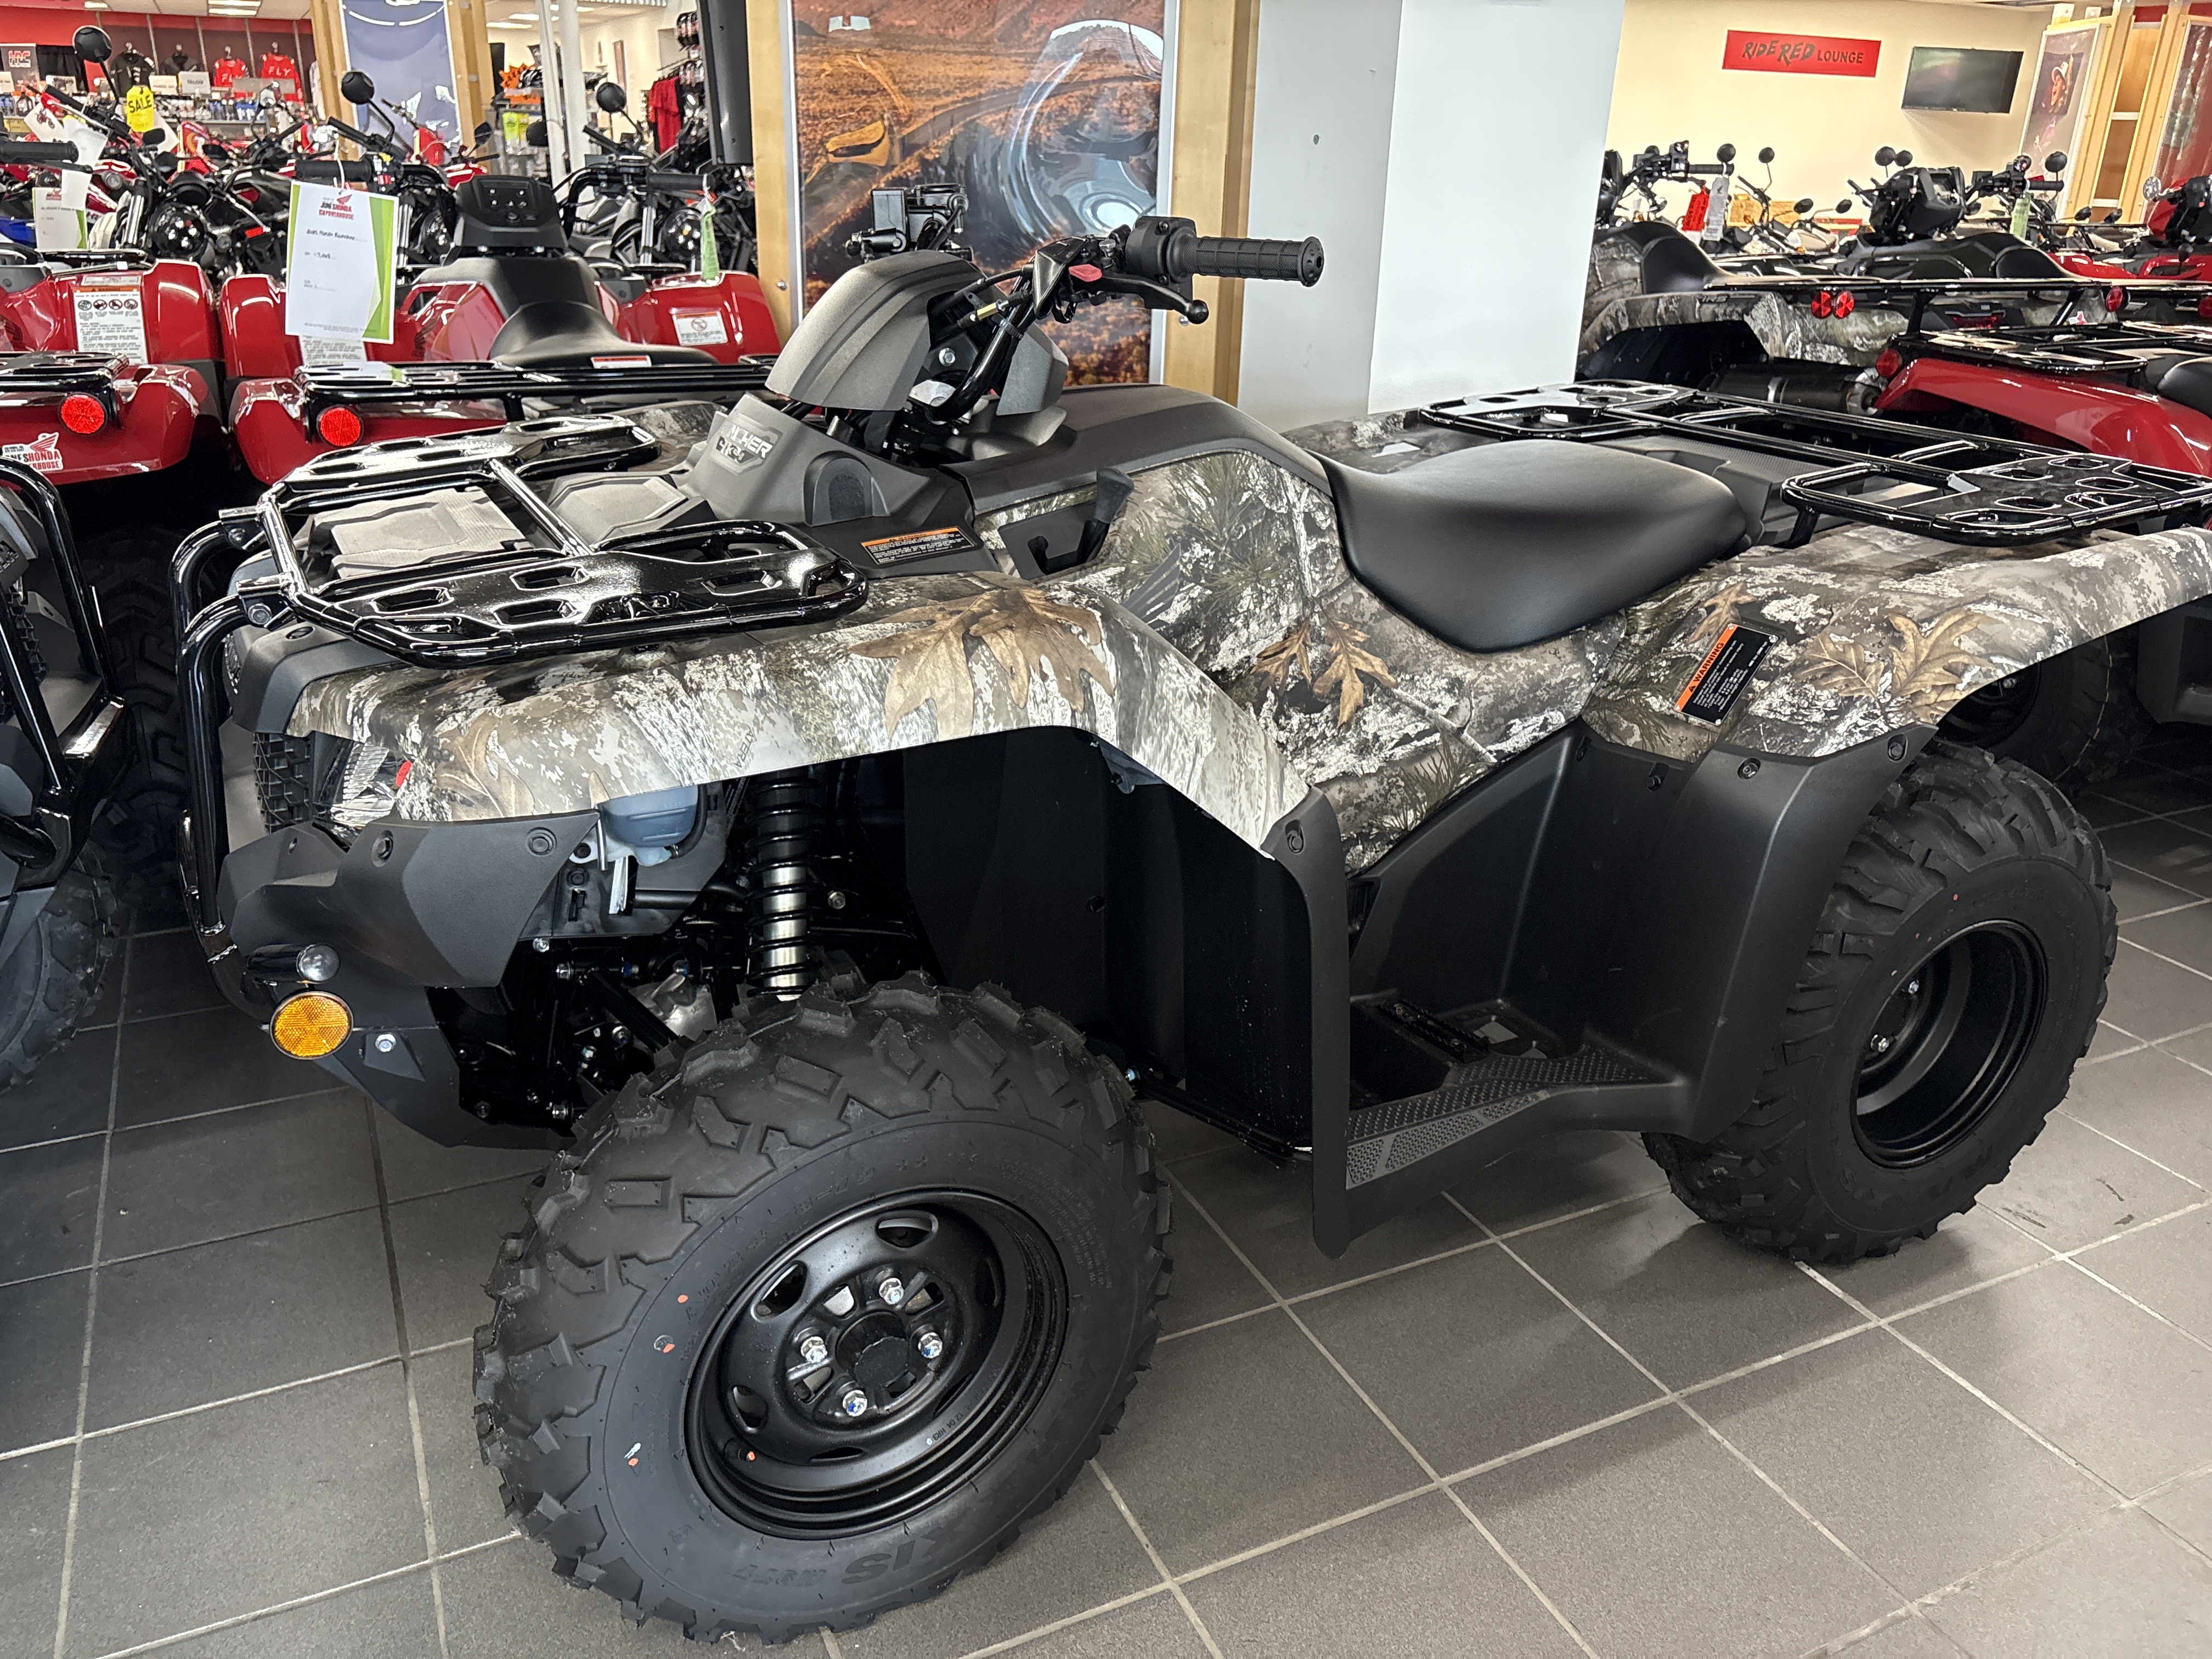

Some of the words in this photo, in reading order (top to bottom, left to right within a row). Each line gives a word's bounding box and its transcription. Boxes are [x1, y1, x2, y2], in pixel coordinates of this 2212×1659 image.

[1742, 40, 1780, 60] RIDE
[1777, 42, 1815, 66] RED
[1816, 49, 1864, 64] LOUNGE
[268, 65, 291, 76] FLY
[128, 94, 153, 114] SALE
[1693, 642, 1725, 682] WARNING
